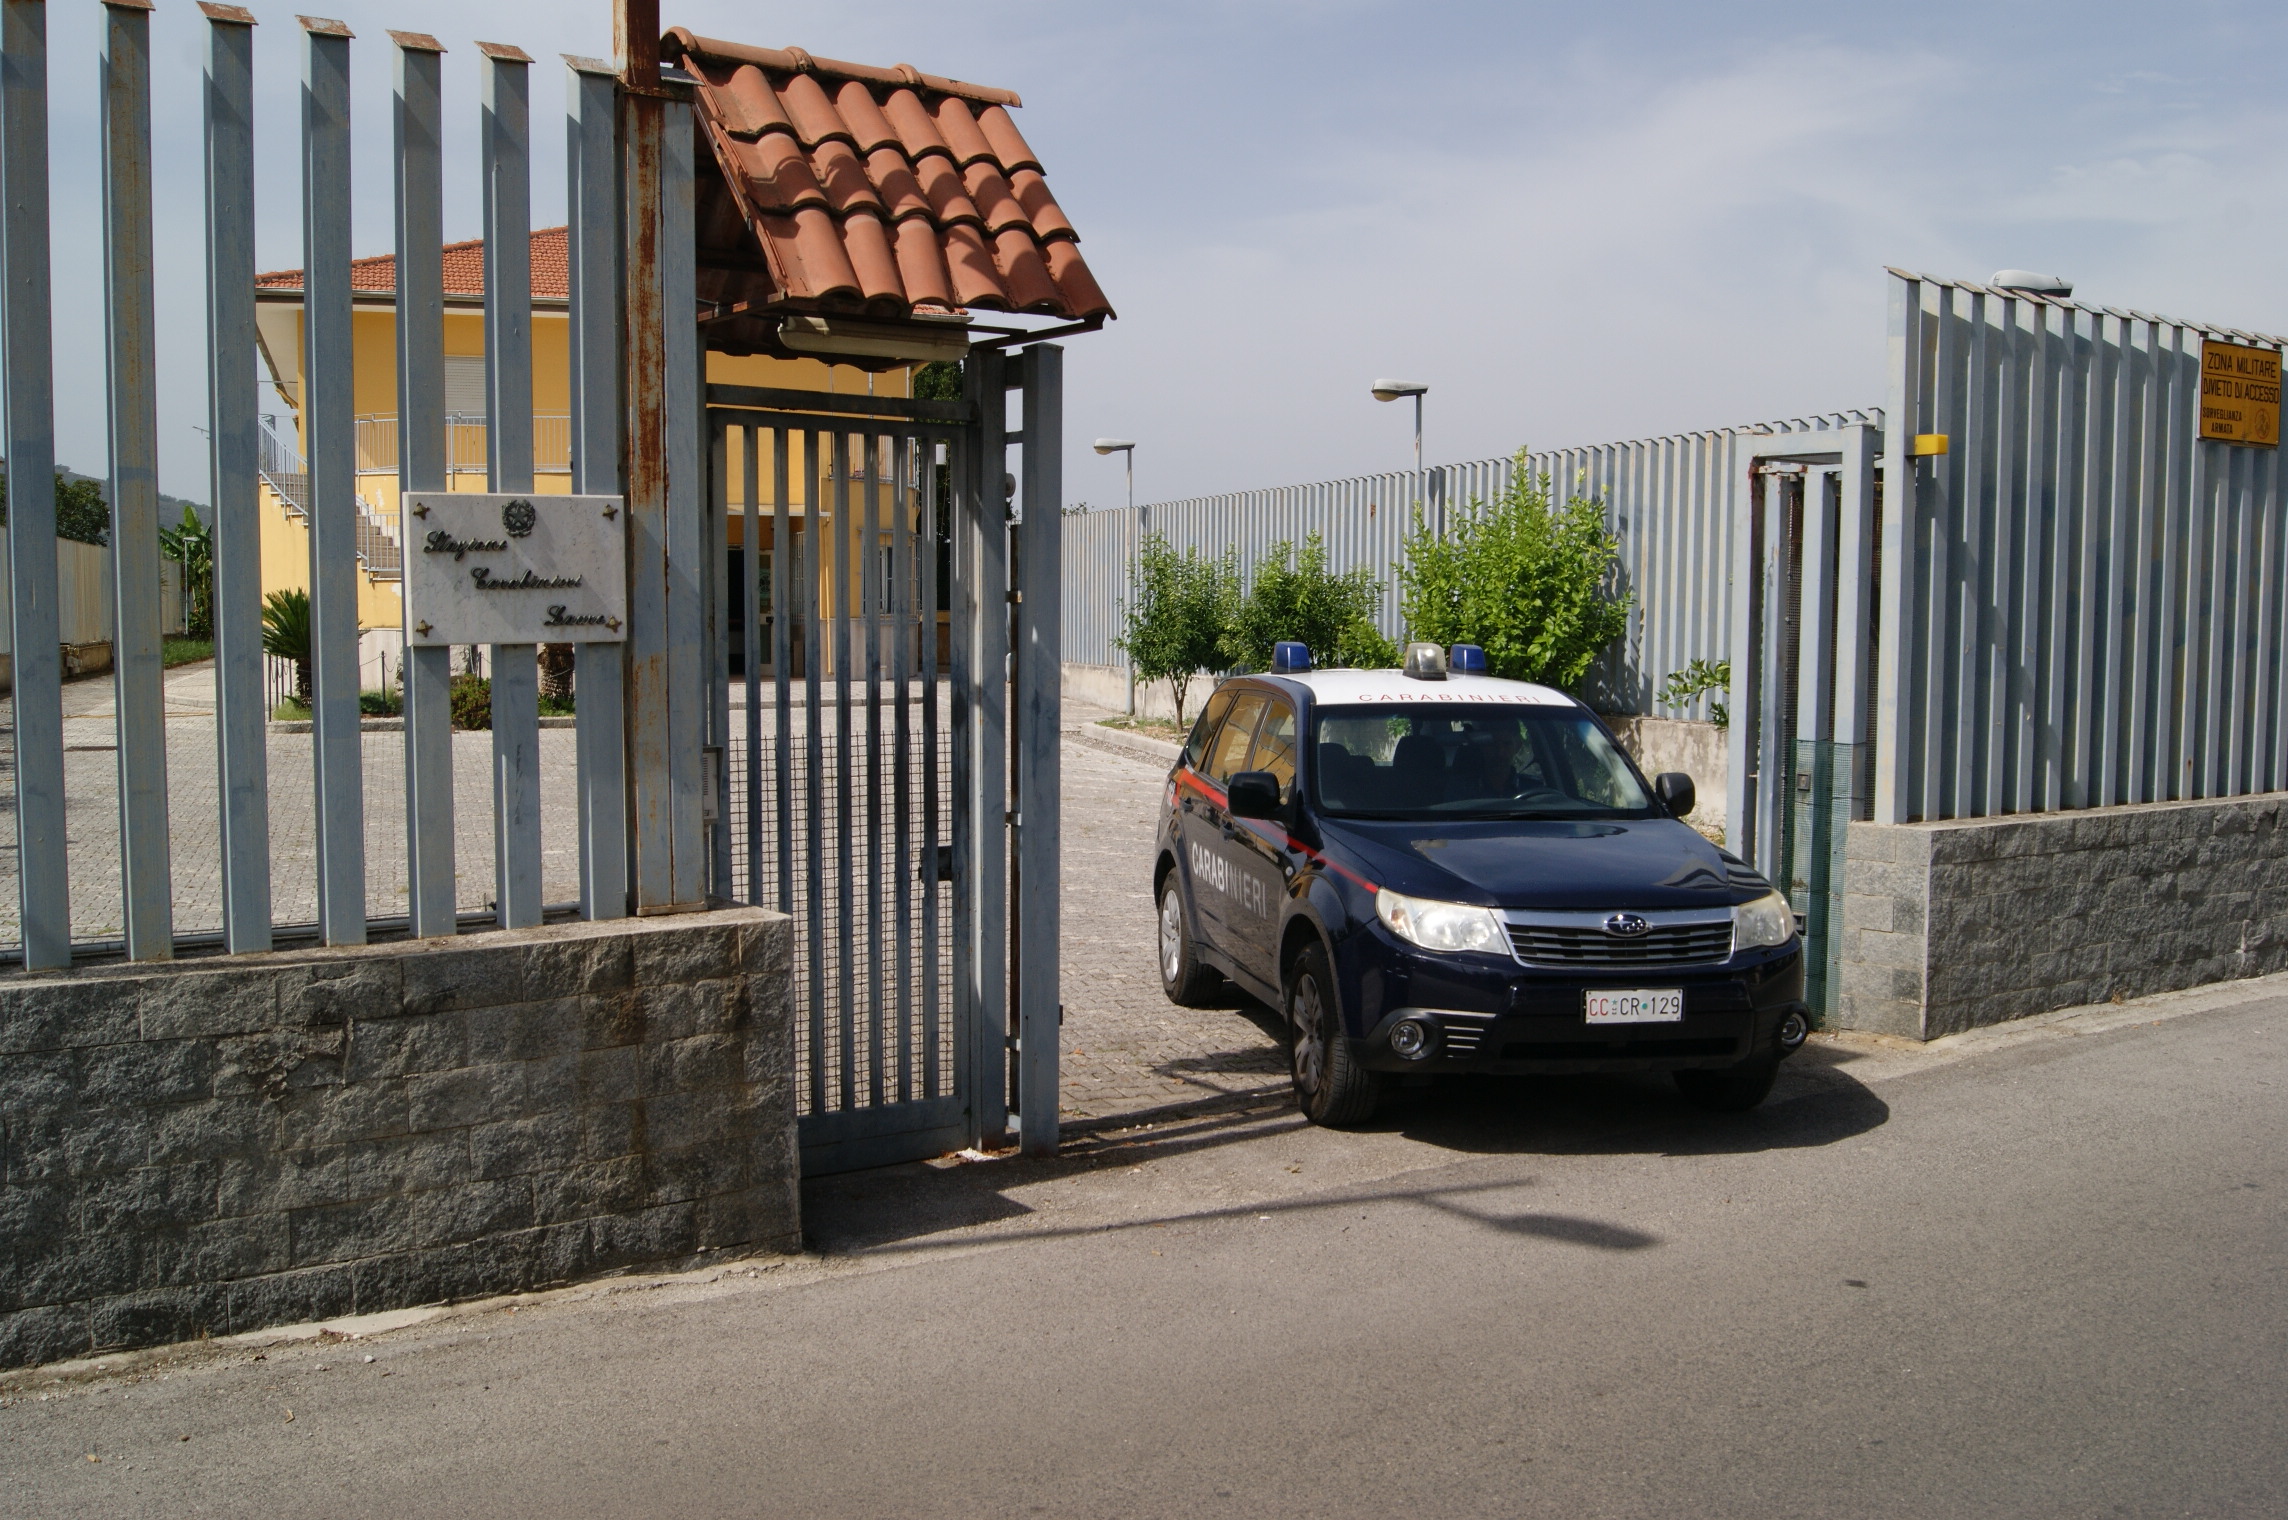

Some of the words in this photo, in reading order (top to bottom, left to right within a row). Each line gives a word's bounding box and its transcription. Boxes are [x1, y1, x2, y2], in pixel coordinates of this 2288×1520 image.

[2207, 352, 2232, 372] ZONA
[2236, 356, 2277, 379] MILITARE
[2203, 378, 2232, 397] DIVIETO
[2234, 381, 2243, 399] DI
[2244, 384, 2279, 404] ACCESSO
[2202, 406, 2242, 421] SORVEGLIANZA
[2210, 422, 2233, 434] ARMATA
[471, 567, 582, 590] Carabinieri
[1359, 694, 1541, 704] CARABINIERI
[1191, 841, 1267, 920] CARABINIERI
[1589, 998, 1608, 1017] CC
[1620, 997, 1640, 1016] CR
[1651, 996, 1680, 1015] 129
